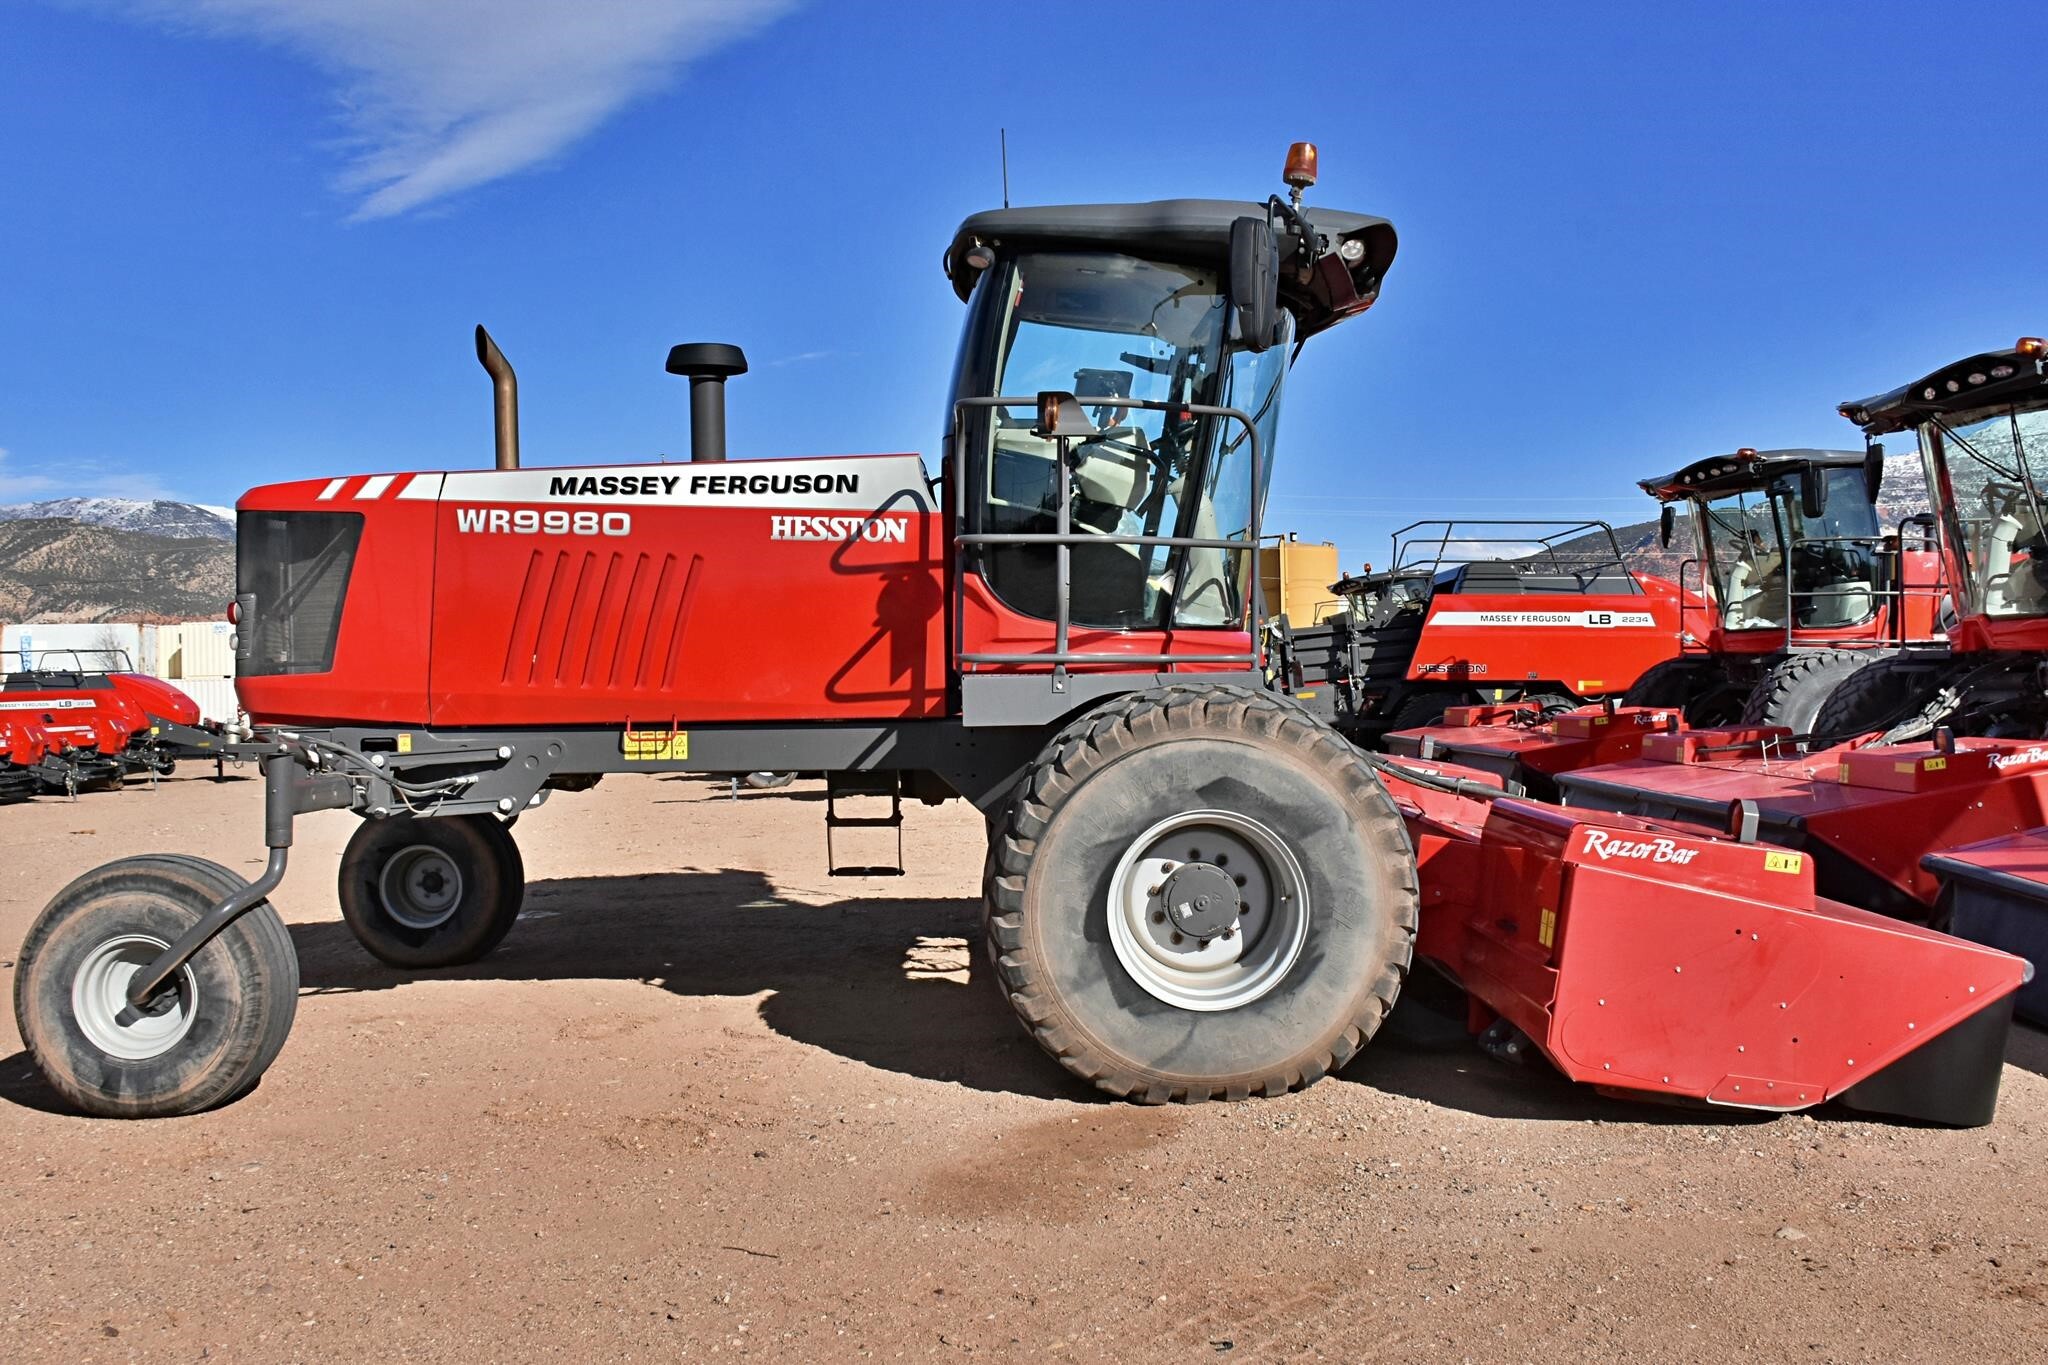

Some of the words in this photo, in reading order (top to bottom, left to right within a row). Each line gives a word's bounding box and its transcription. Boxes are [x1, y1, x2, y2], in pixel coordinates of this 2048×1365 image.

[550, 476, 680, 496] MASSEY
[690, 474, 859, 494] FERGUSON
[456, 508, 631, 536] WR9980
[770, 515, 908, 543] HESSTON
[1480, 614, 1518, 623] MASSEY
[1521, 614, 1571, 623] FERGUSON
[1588, 614, 1611, 625] LB
[1417, 663, 1487, 673] HESSTON
[1633, 711, 1667, 724] RazorB
[1986, 747, 2048, 770] RazorBa
[1583, 830, 1700, 865] RazorBar
